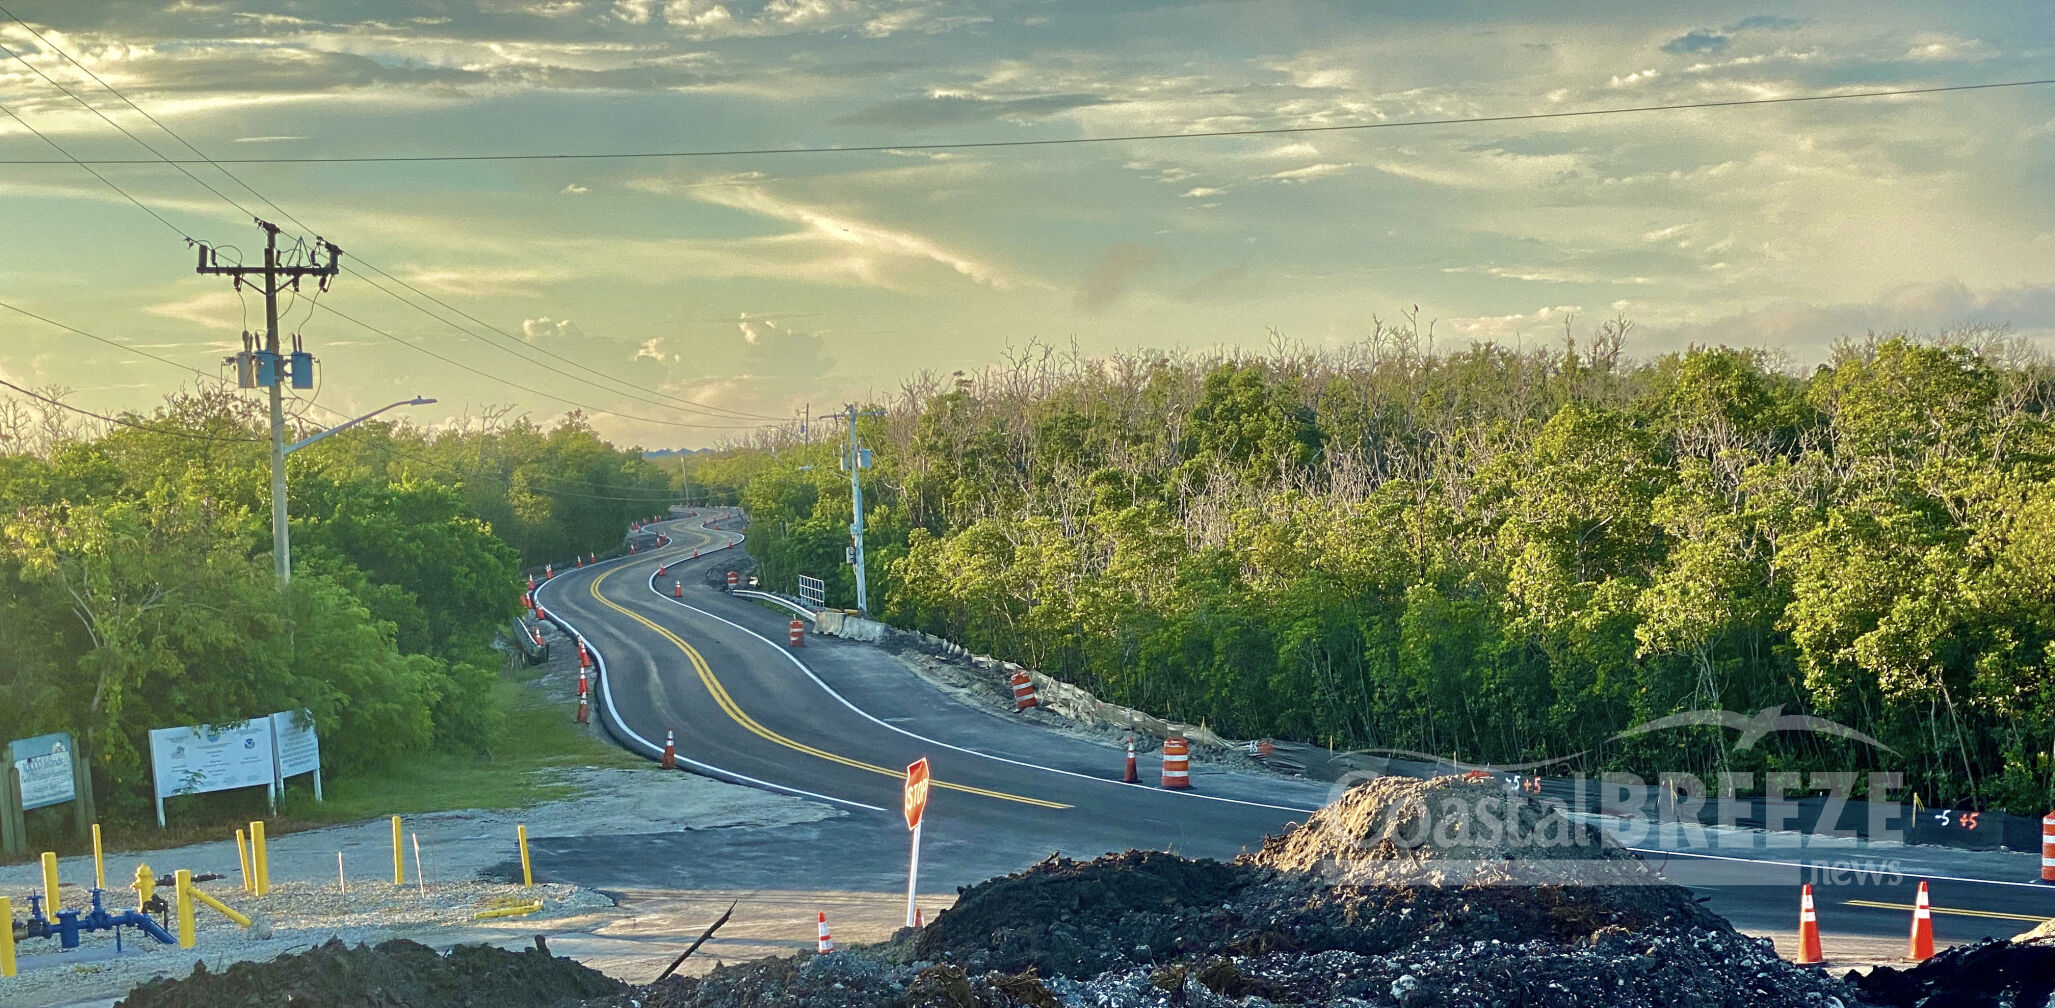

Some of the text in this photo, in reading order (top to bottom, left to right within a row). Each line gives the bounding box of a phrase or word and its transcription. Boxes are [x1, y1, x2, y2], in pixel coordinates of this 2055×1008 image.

[906, 778, 927, 810] STOP
[1935, 809, 1980, 831] -5 +5
